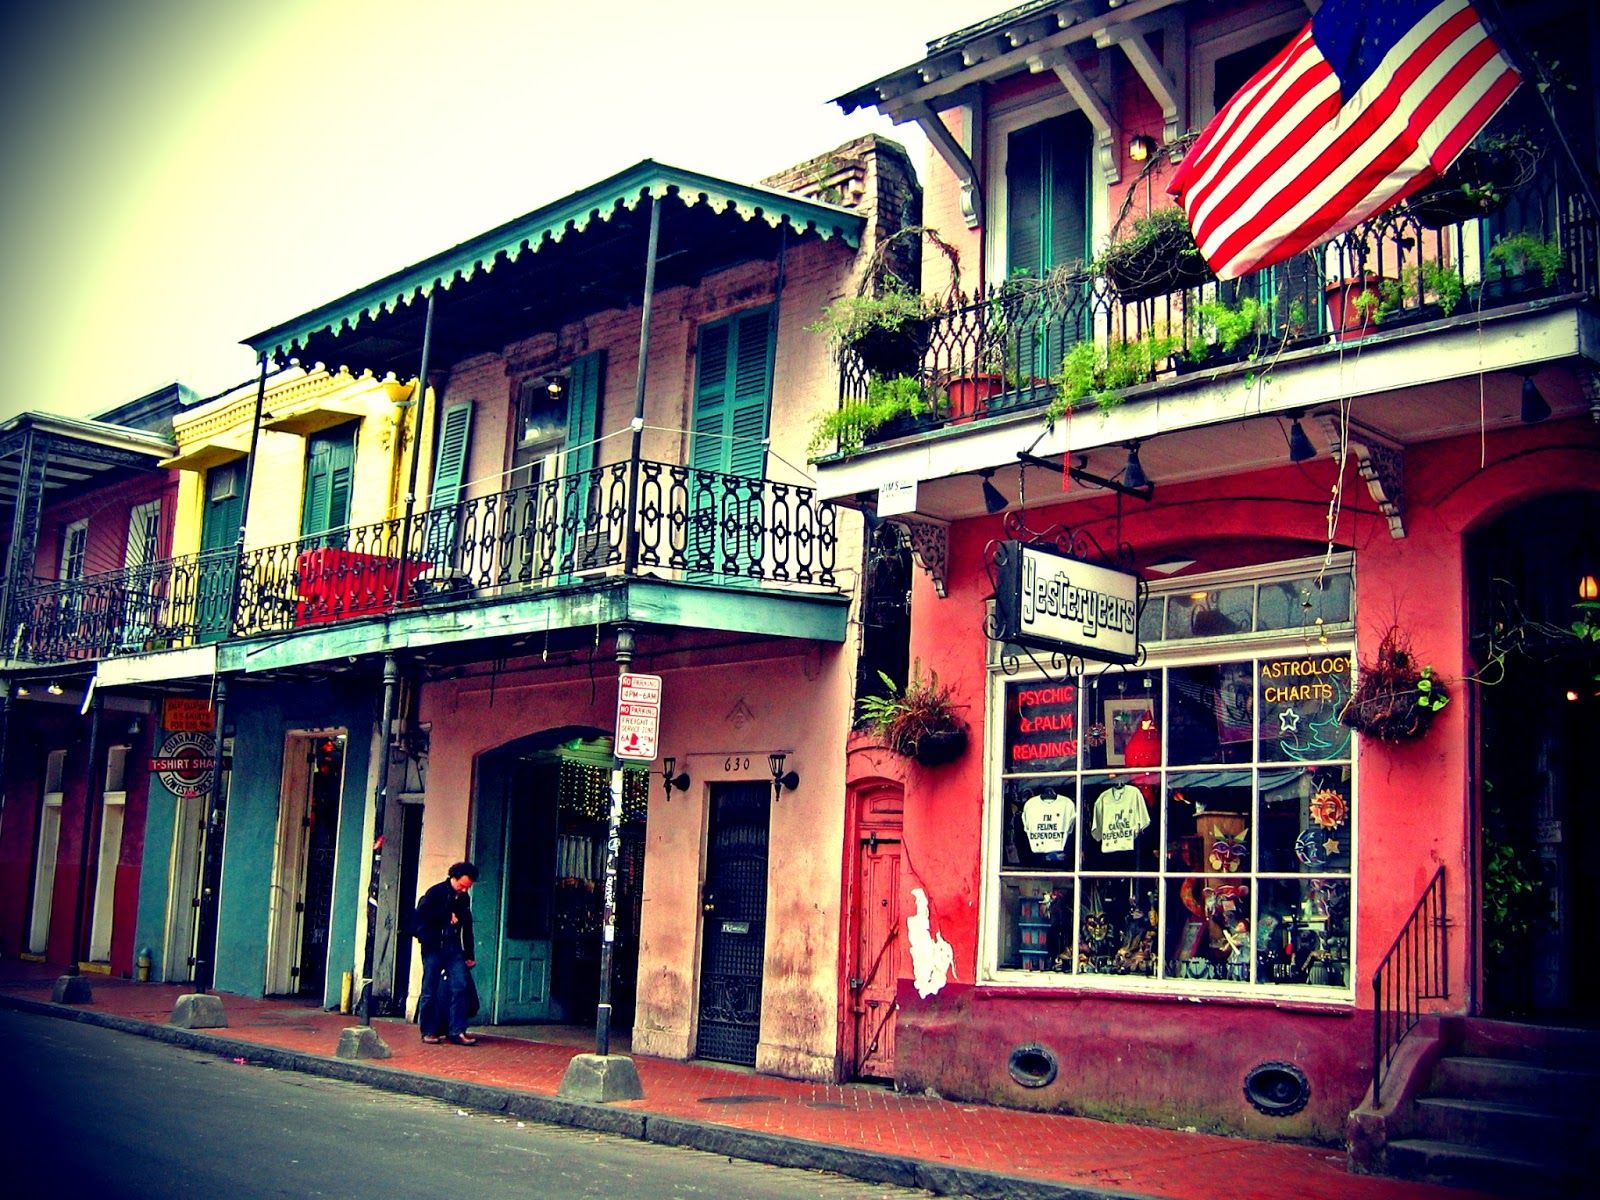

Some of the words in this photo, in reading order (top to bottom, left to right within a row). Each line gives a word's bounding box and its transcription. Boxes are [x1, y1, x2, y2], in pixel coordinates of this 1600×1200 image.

[1023, 556, 1135, 638] Yesteryears
[1261, 657, 1351, 679] ASTROLOGY
[622, 677, 631, 686] NO
[633, 679, 657, 688] PARKING
[1018, 686, 1074, 706] PSYCHIC
[1264, 684, 1333, 703] CHARTS
[621, 705, 630, 714] NO
[631, 706, 655, 715] PARKING
[1034, 714, 1073, 731] PALM
[1013, 739, 1078, 760] READINGS
[152, 760, 189, 769] T-SHIRT
[725, 757, 750, 771] 630
[1037, 823, 1058, 831] FELINE
[1030, 832, 1064, 840] DEPENDENT
